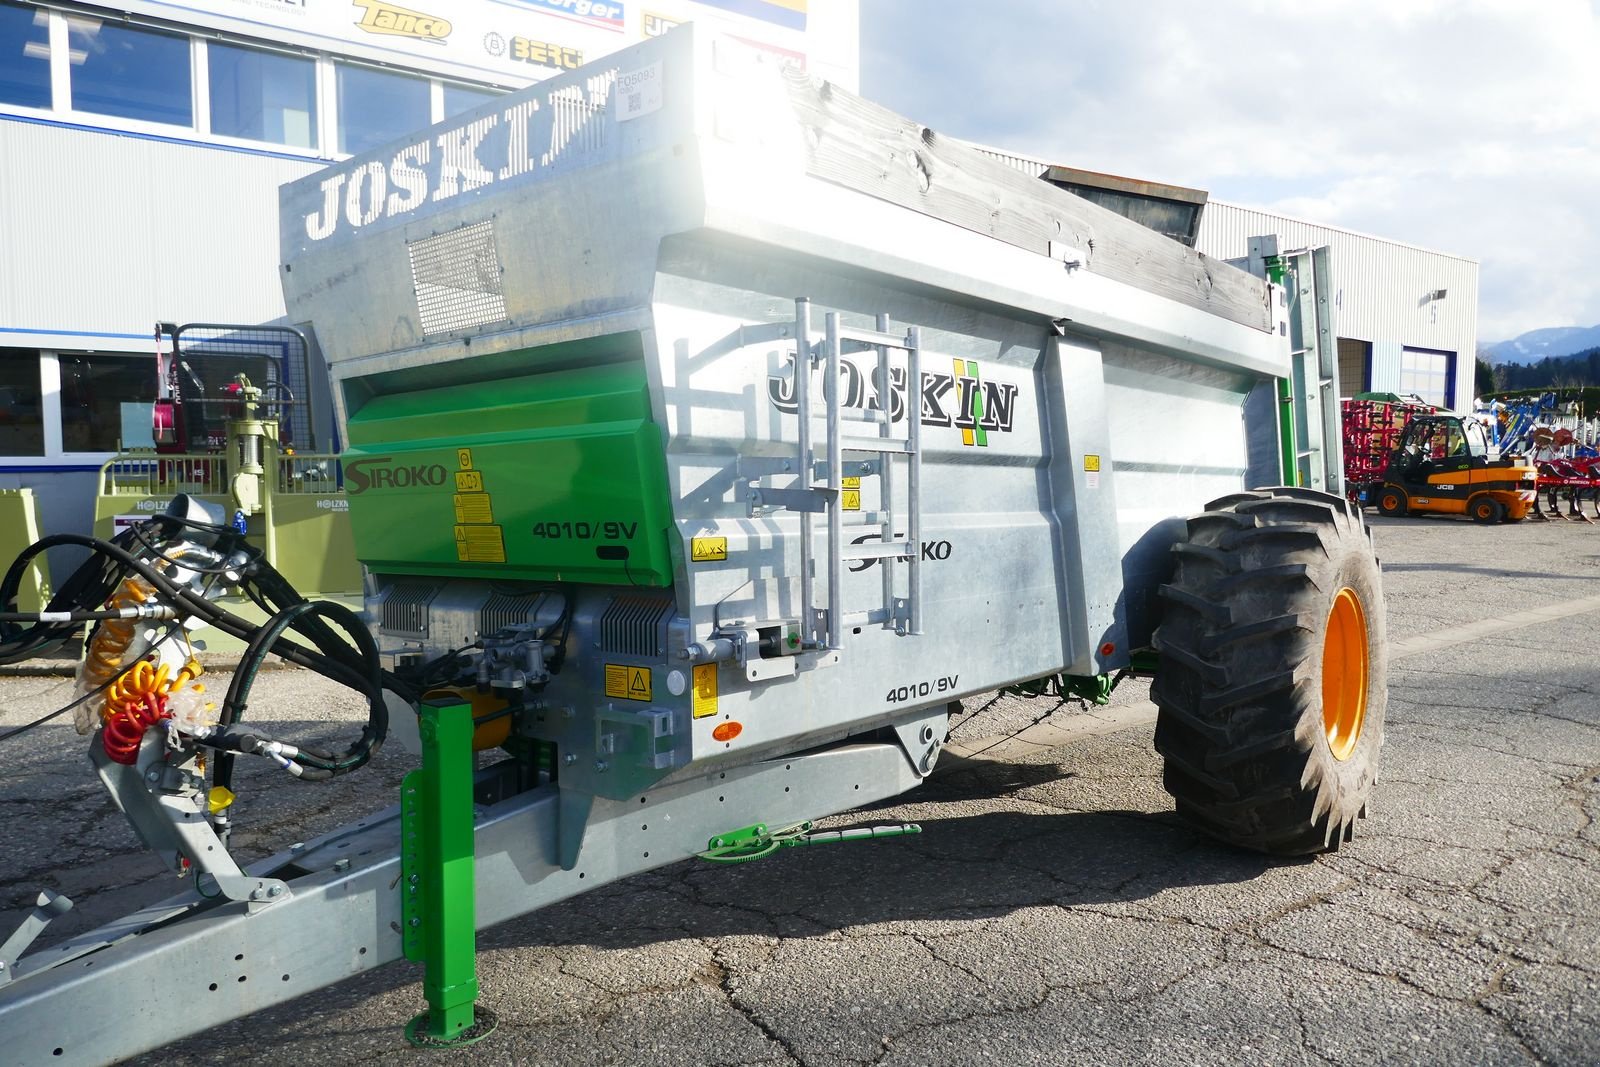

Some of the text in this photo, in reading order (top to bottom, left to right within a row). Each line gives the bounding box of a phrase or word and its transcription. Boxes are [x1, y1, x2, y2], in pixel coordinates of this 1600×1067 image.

[353, 0, 452, 39] Tanco
[304, 66, 620, 241] JOSKIN
[766, 349, 1018, 432] JOSKIN
[345, 457, 447, 496] SIROKO
[532, 521, 638, 540] 4010/9V
[886, 674, 959, 703] 4010/9V
